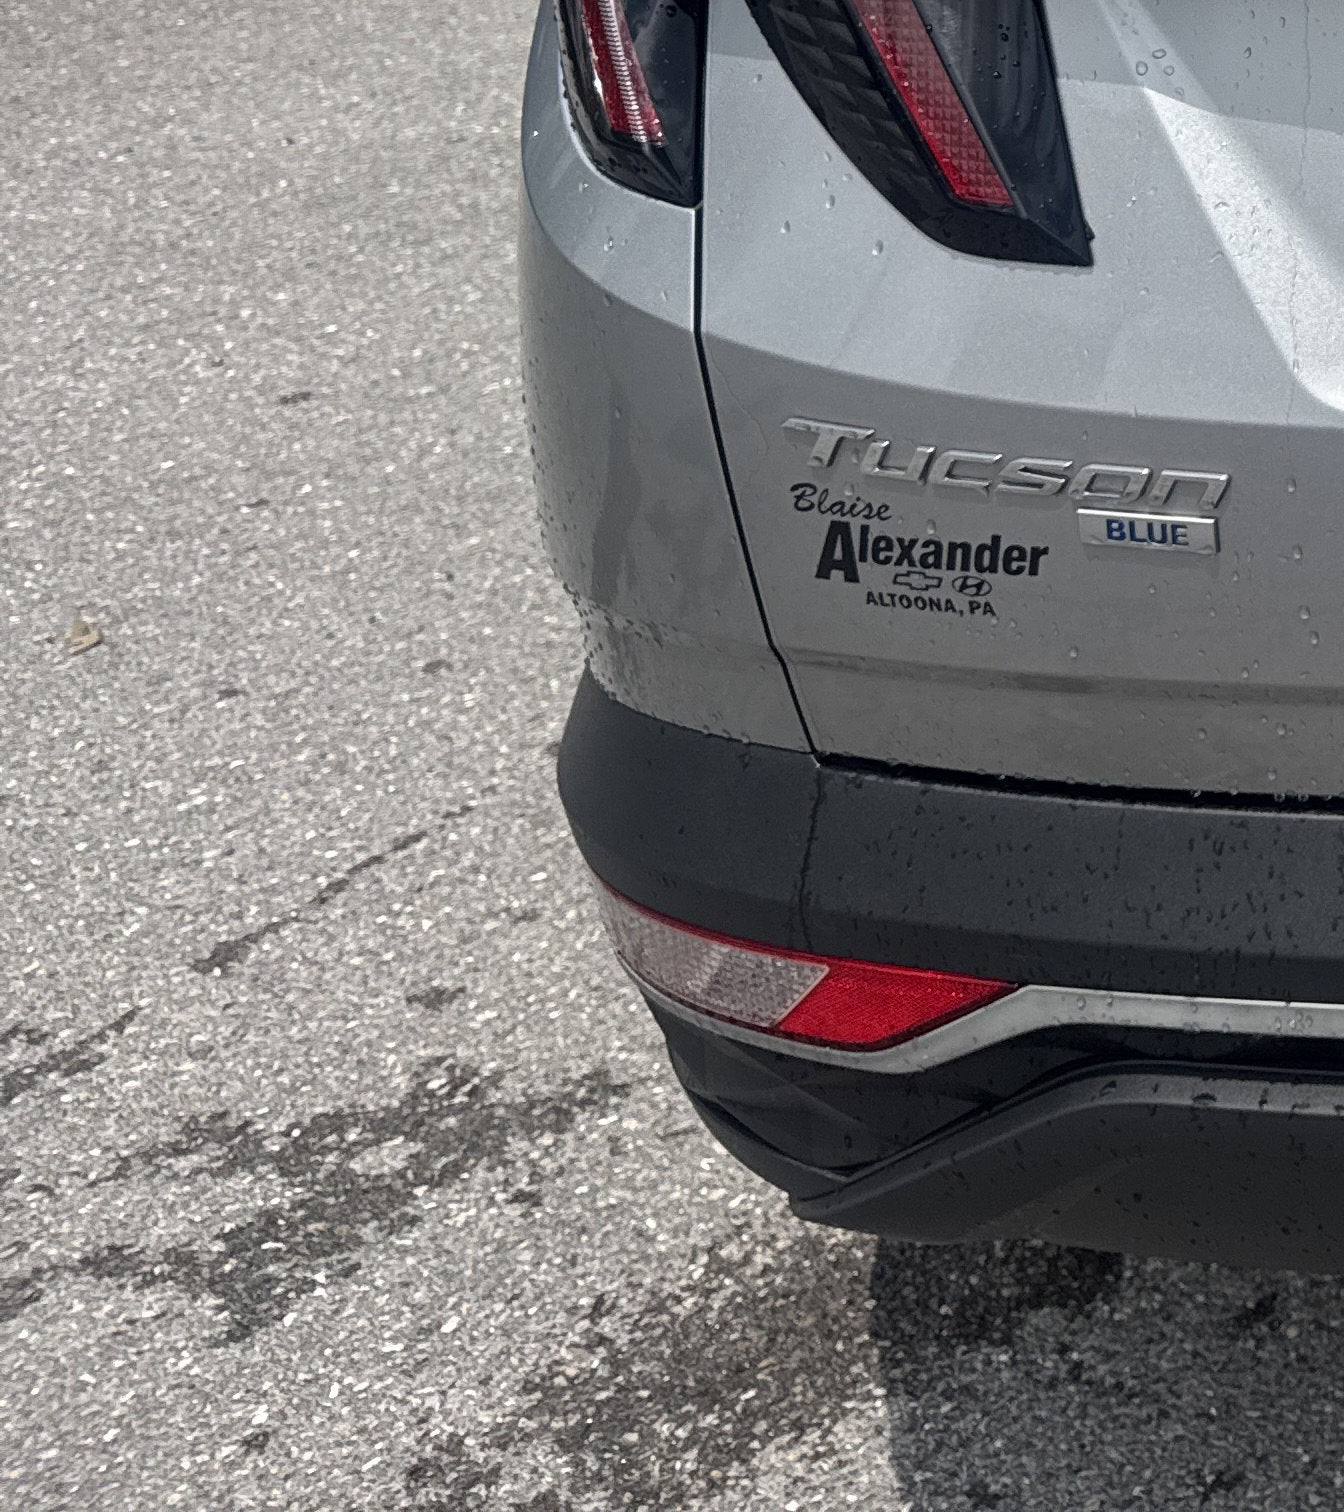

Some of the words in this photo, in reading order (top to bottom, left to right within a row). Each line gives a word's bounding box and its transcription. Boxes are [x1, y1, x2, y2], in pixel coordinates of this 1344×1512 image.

[789, 483, 893, 522] Blaise
[1105, 518, 1190, 547] BLUE
[815, 520, 1050, 584] Alexander
[865, 591, 966, 618] ALTOONA,
[968, 600, 997, 617] PA
